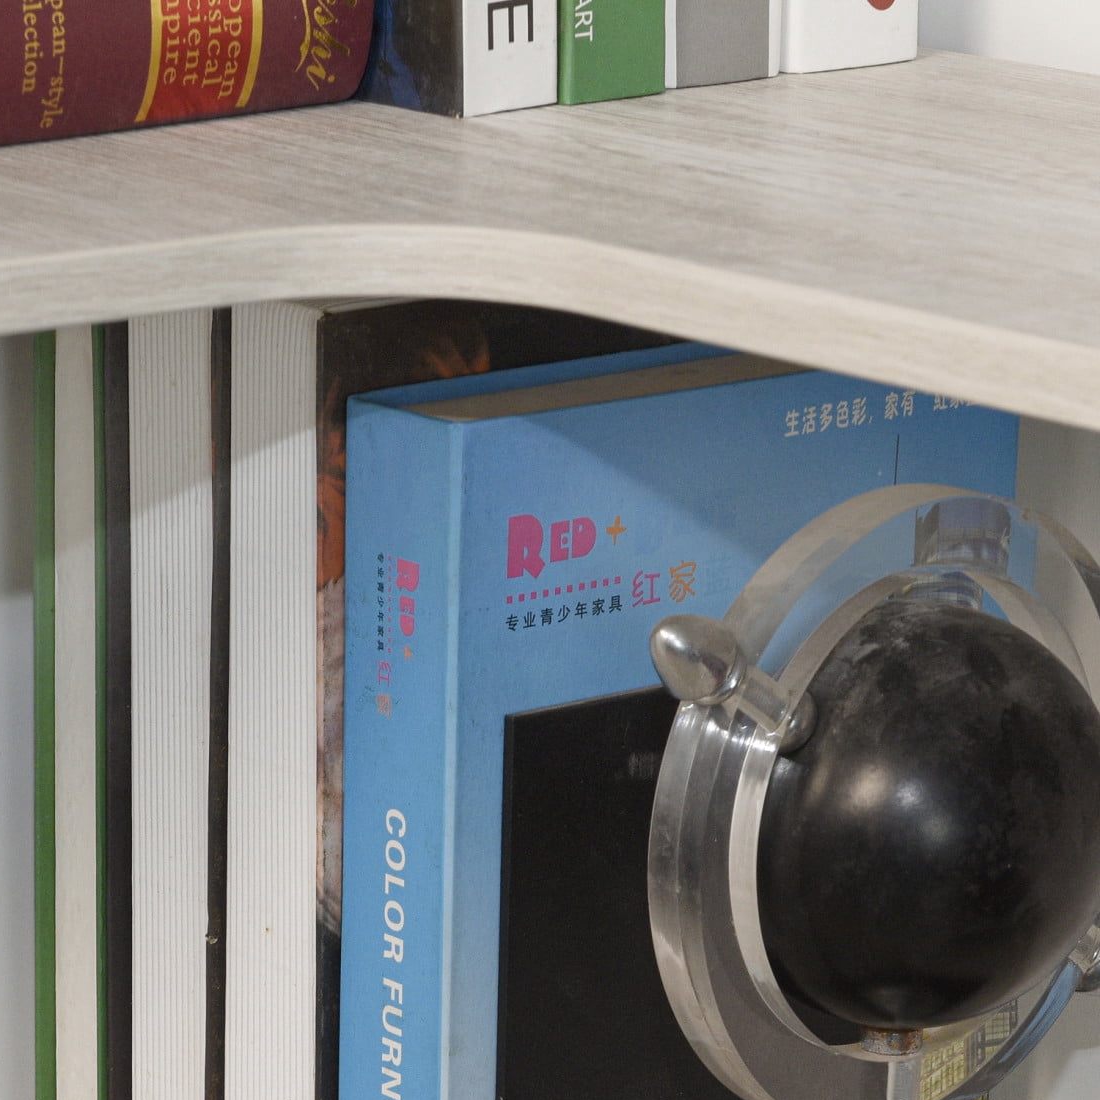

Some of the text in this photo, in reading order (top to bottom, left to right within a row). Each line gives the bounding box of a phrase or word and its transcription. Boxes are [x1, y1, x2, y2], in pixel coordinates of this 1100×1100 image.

[21, 0, 43, 95] lection
[487, 0, 534, 51] E
[505, 595, 623, 632] 专业青少年家具
[383, 808, 407, 964] COLOR
